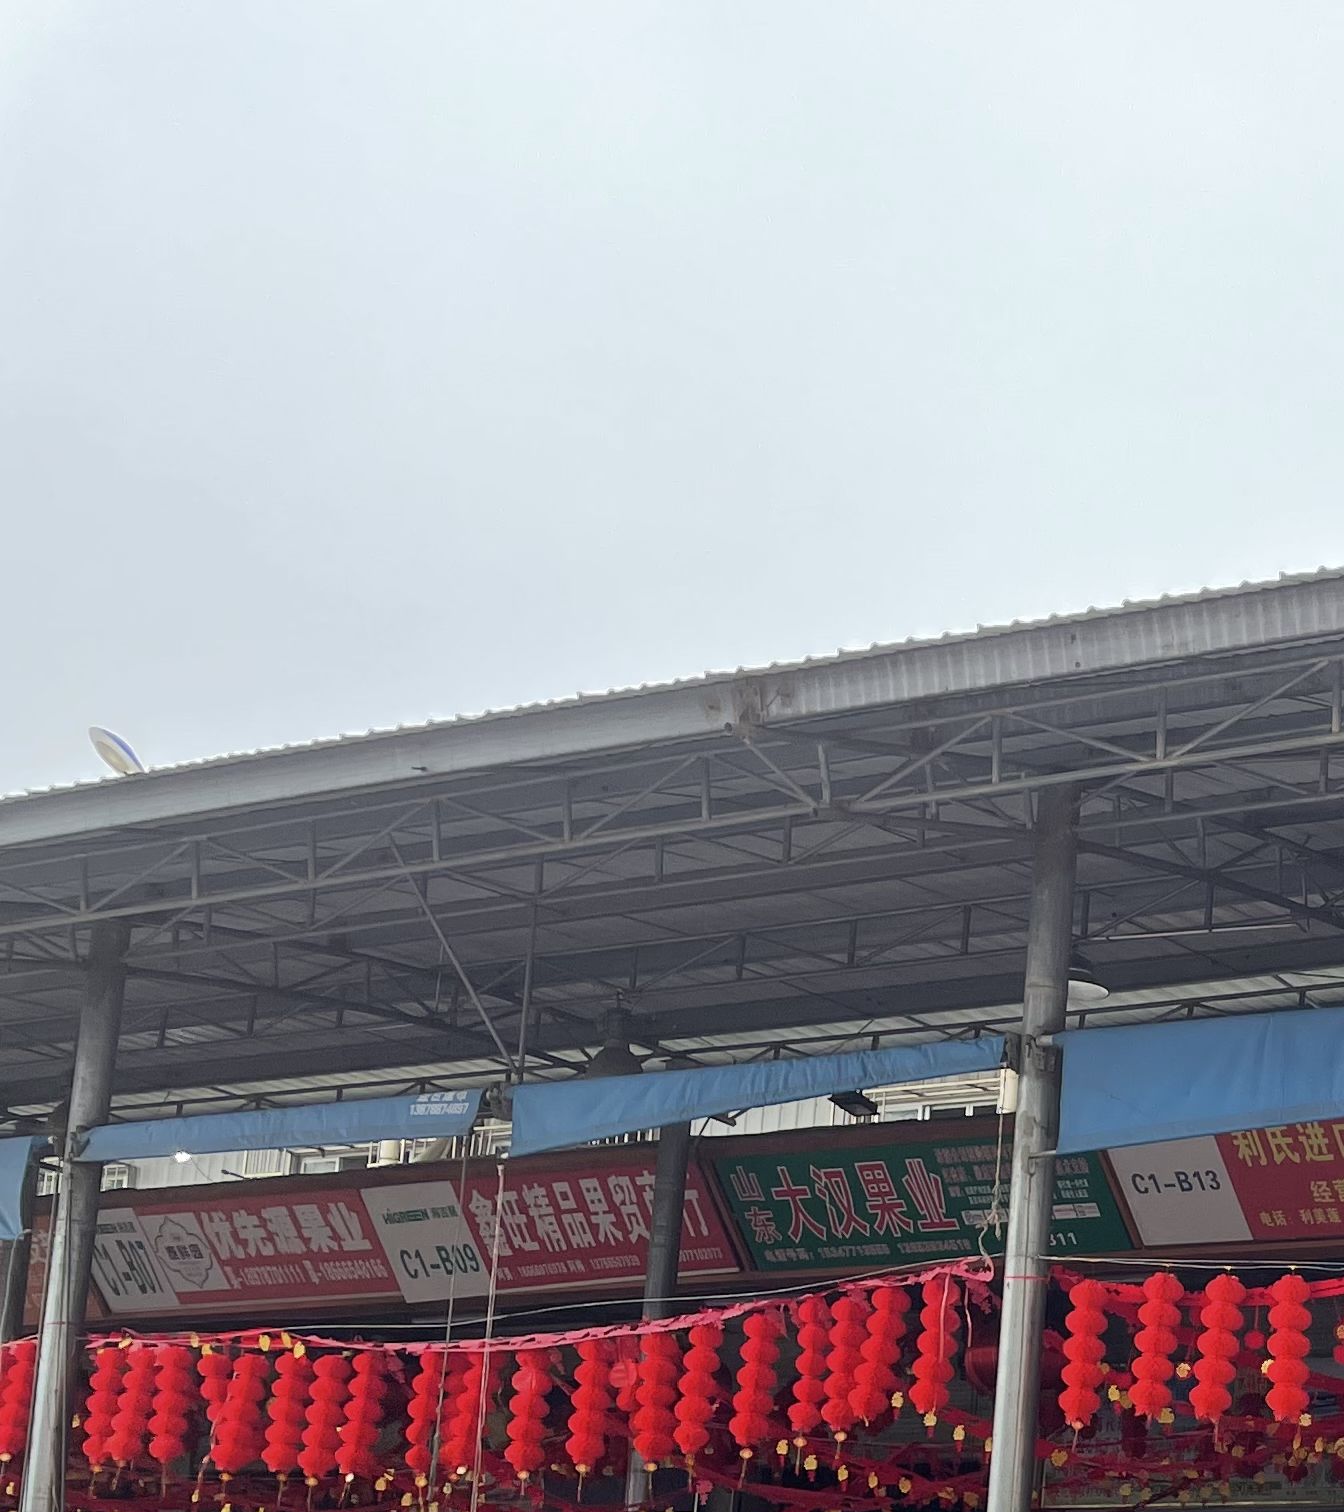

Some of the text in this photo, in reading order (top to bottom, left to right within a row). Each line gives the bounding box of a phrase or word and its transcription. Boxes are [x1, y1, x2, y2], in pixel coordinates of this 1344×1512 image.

[730, 1164, 783, 1245] 山东
[770, 1157, 959, 1244] 大汉果业
[1131, 1169, 1221, 1195] C1-B13
[400, 1242, 481, 1280] C1-B09
